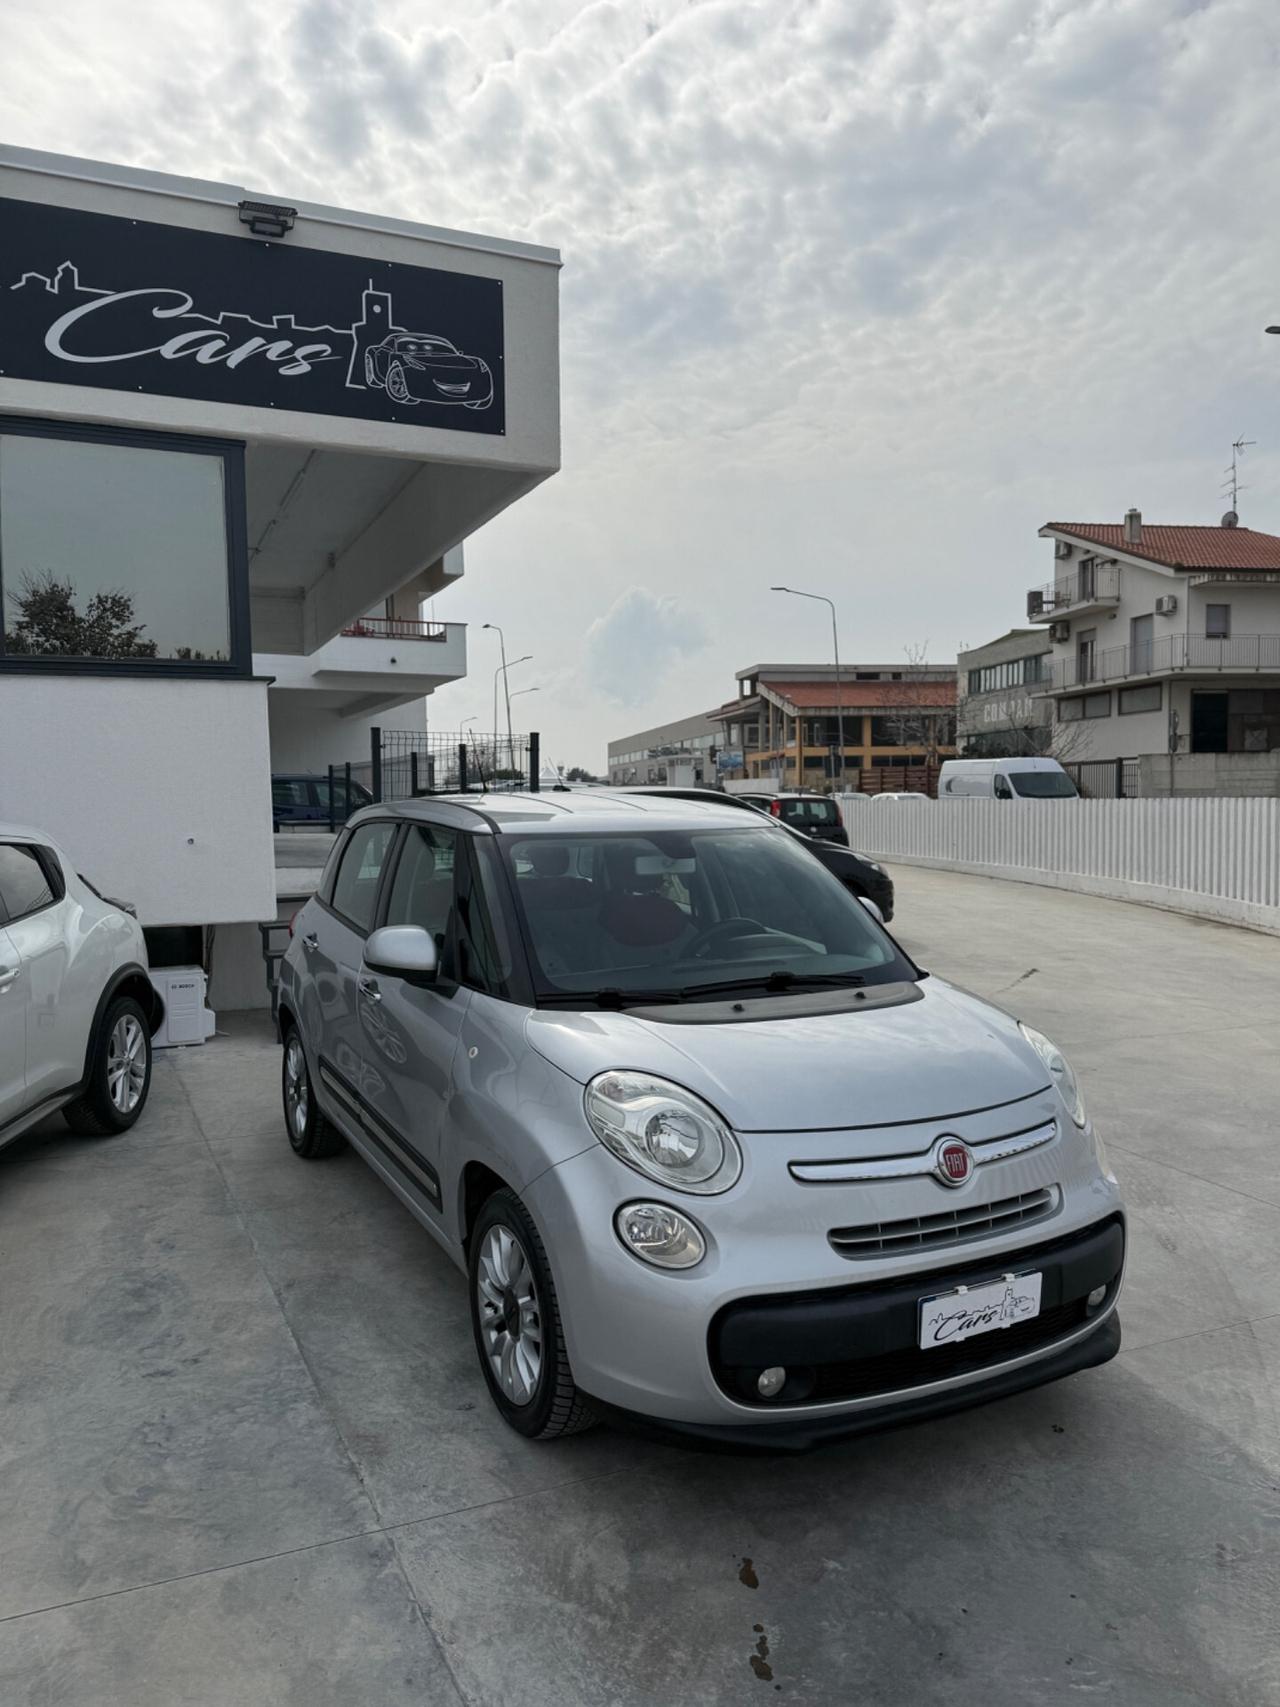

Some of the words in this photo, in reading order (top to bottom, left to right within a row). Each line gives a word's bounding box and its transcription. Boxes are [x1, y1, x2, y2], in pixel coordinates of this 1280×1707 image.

[45, 288, 343, 376] Cars
[945, 1153, 965, 1173] FIAT
[934, 1309, 998, 1341] Cars
